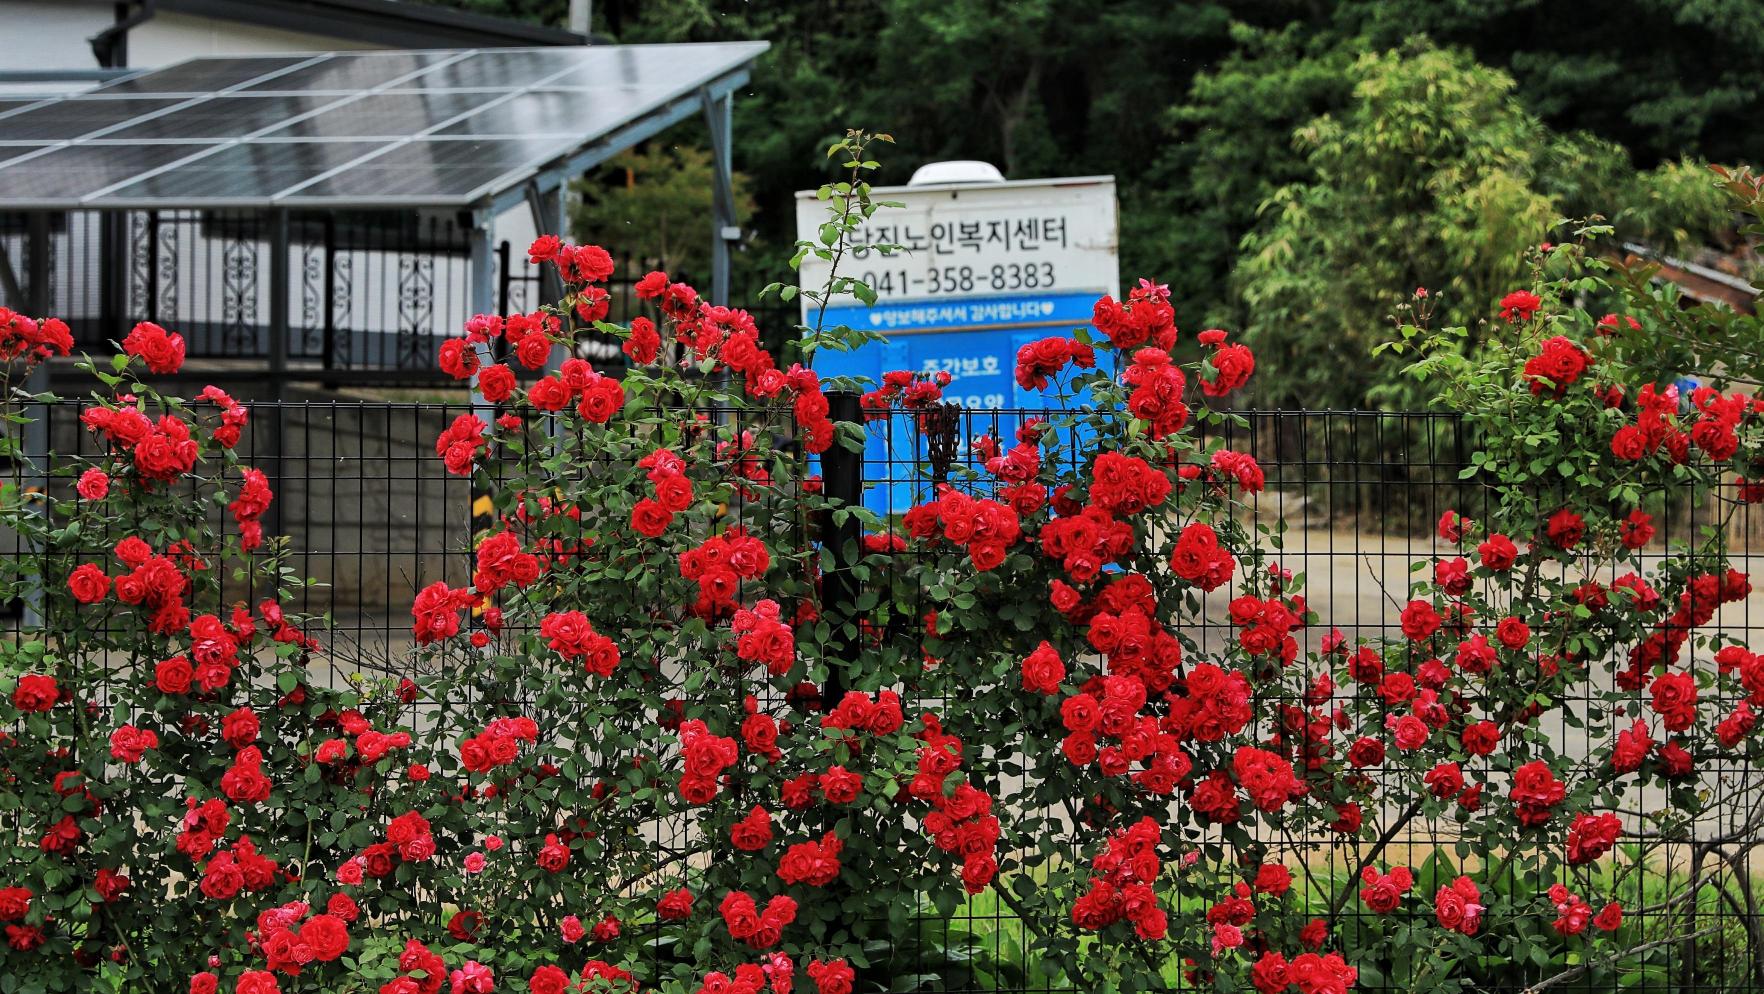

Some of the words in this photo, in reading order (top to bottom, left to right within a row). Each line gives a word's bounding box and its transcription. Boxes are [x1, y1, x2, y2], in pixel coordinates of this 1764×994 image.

[848, 215, 1068, 261] 당진노인복지센터
[862, 262, 1056, 296] 041-358-8383
[969, 301, 1041, 321] 감사합니다
[922, 355, 1001, 380] 주간보호
